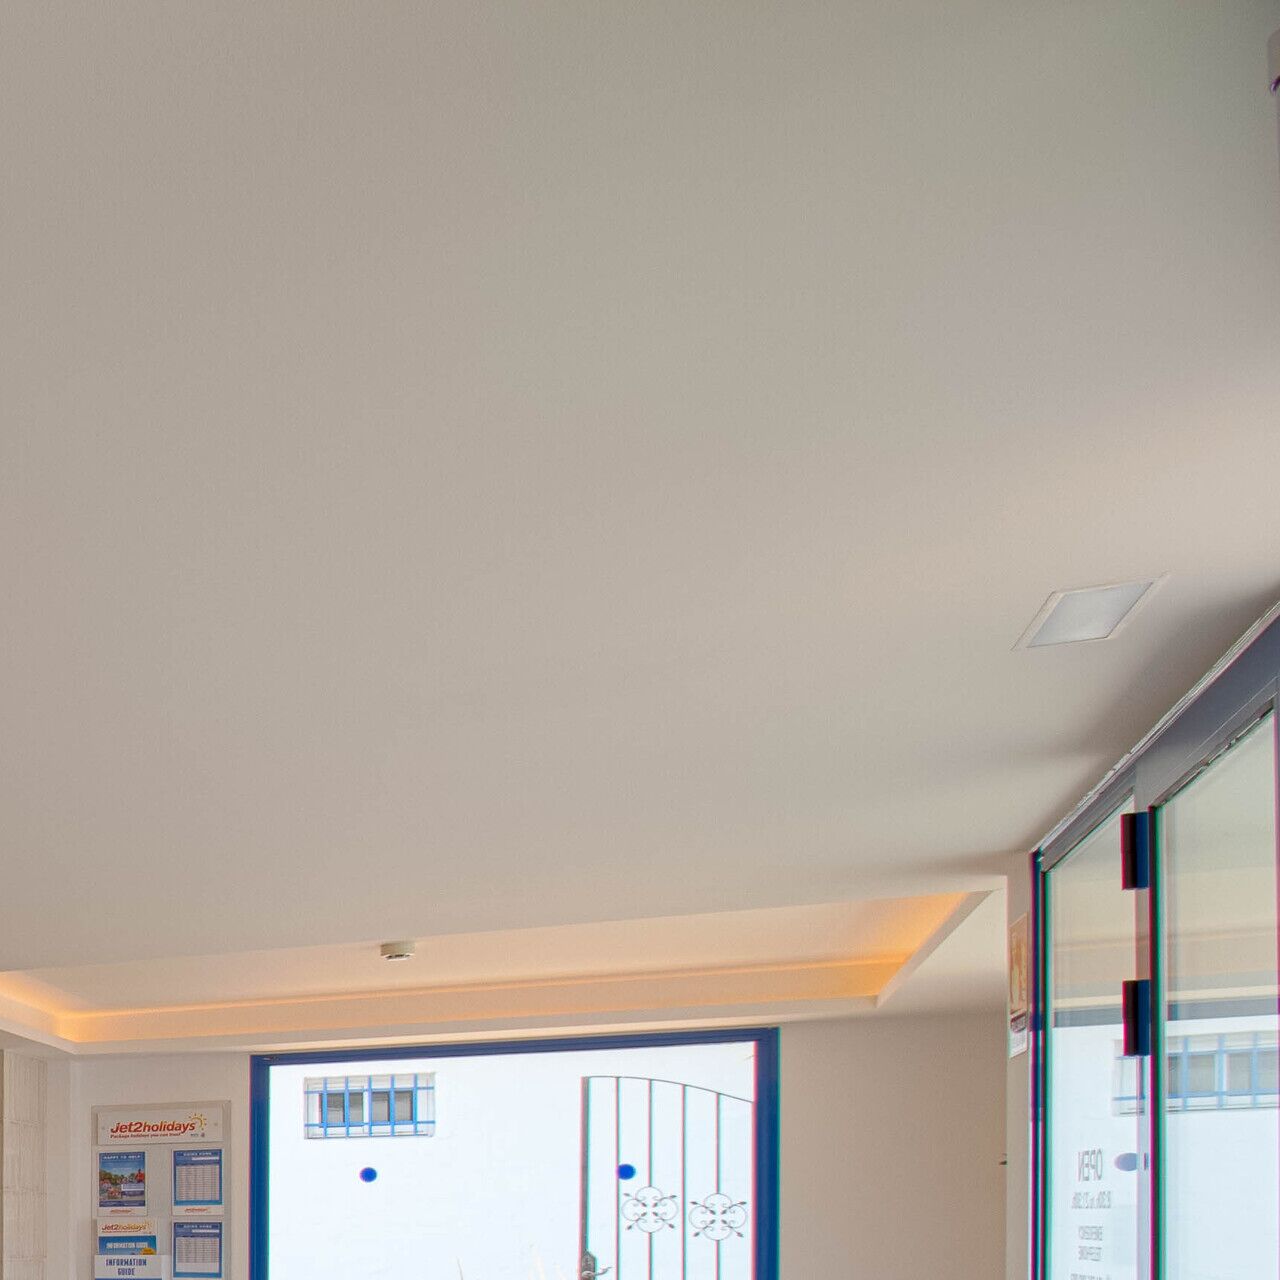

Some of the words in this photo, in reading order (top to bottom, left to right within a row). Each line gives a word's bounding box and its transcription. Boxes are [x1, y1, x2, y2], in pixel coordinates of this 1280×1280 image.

[110, 1121, 196, 1134] Jet2holidays
[105, 1258, 147, 1266] INFORMATION
[117, 1267, 135, 1276] GUIDE
